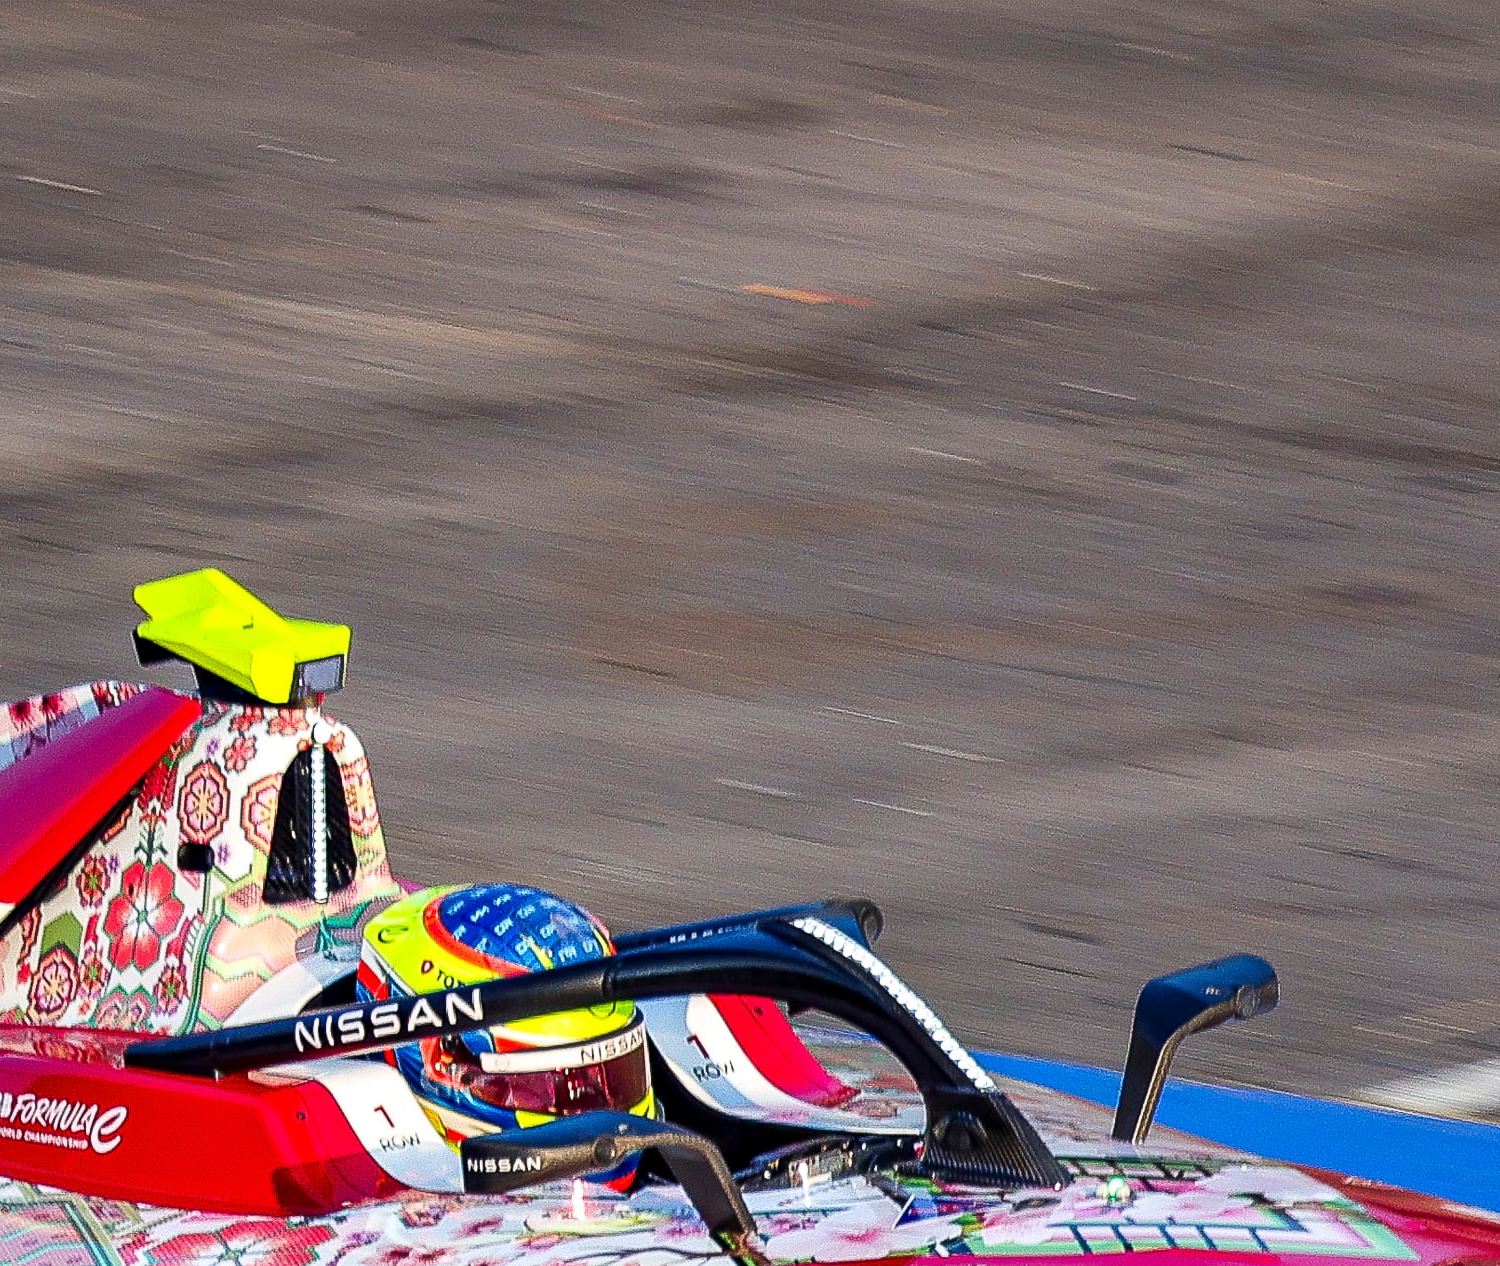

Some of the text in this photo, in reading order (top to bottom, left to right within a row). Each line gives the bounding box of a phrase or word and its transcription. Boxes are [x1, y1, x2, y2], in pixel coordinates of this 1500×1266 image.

[294, 988, 484, 1052] NISSAN
[581, 1024, 644, 1064] NISSAN
[686, 1034, 711, 1059] 1
[10, 1093, 98, 1135] FORMULA
[373, 1104, 395, 1128] 1
[379, 1132, 421, 1153] ROW
[467, 1156, 542, 1174] NISSAN
